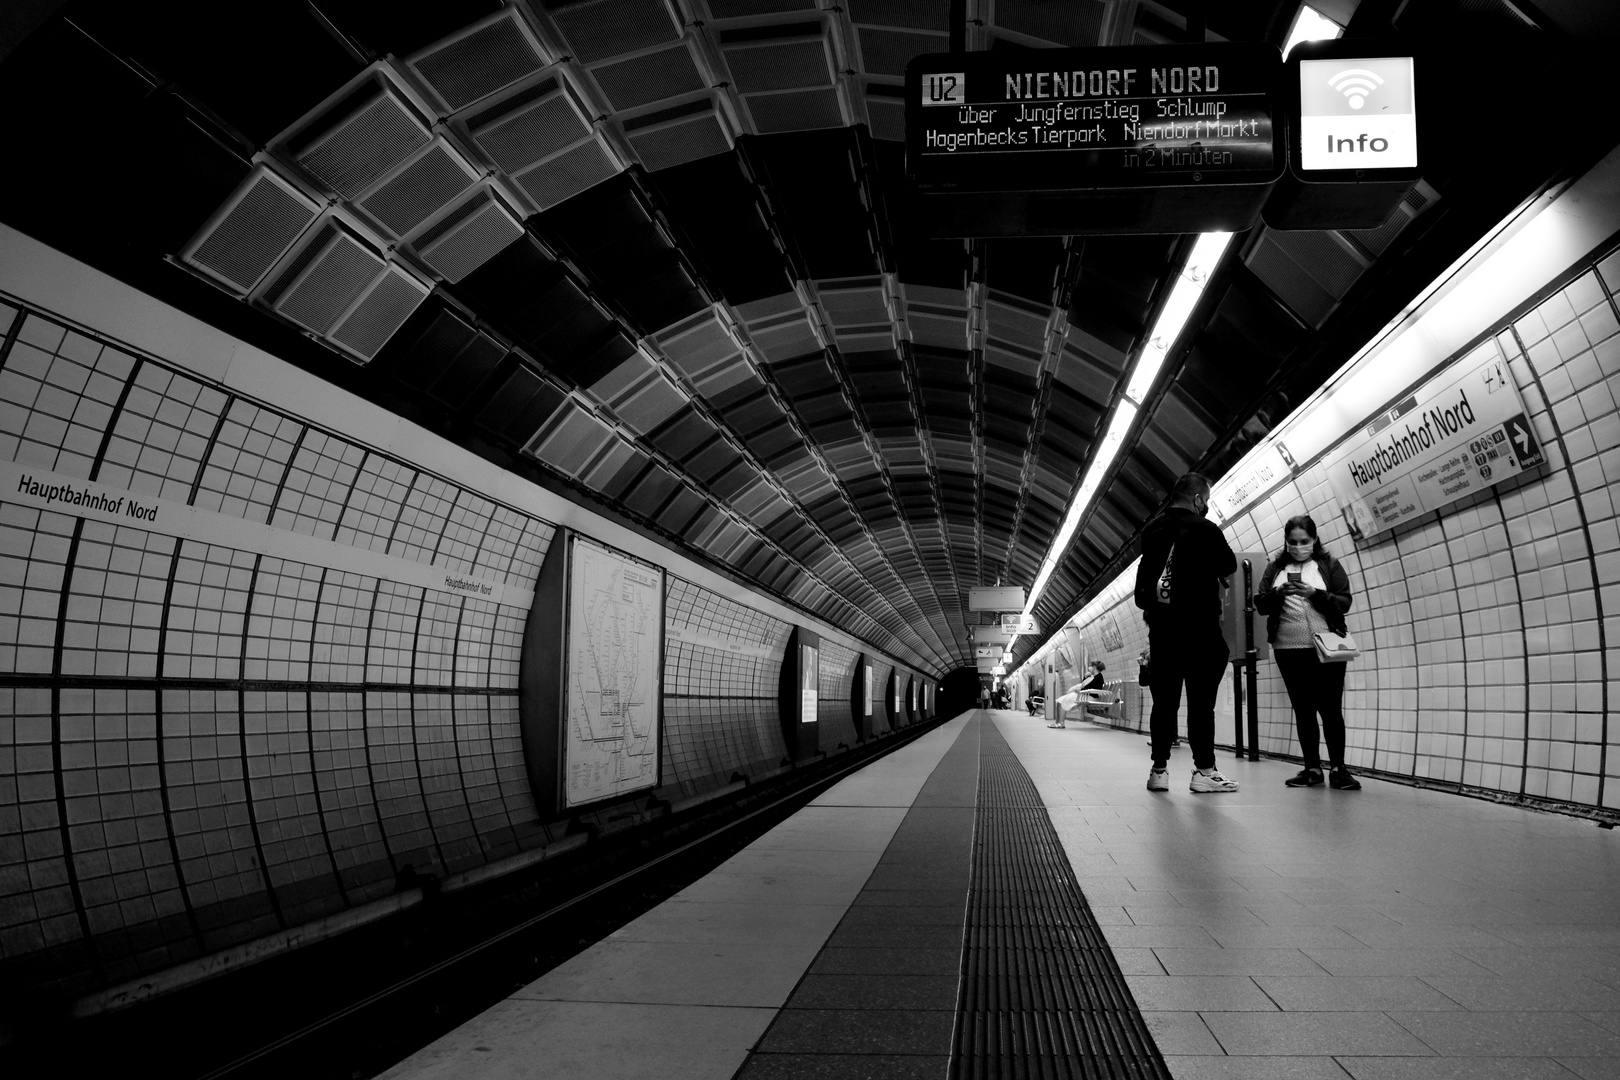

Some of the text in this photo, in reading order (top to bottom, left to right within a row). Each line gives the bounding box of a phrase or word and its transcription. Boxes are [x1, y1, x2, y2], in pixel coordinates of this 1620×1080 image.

[930, 76, 957, 102] U2
[1006, 66, 1219, 99] NIENDORF NORD
[958, 98, 1227, 126] über Jungfernstieg Schlump
[926, 128, 1028, 151] Hagenbecks
[1031, 124, 1107, 148] Tierpark
[1327, 133, 1389, 153] Info
[1122, 147, 1233, 168] in 2 Minuten
[1347, 388, 1476, 488] Hauptbahnhof Nord
[17, 474, 159, 522] Hauptbahnhof Nord
[444, 575, 493, 596] Hauptbahnhof Nord
[1028, 622, 1034, 631] 2
